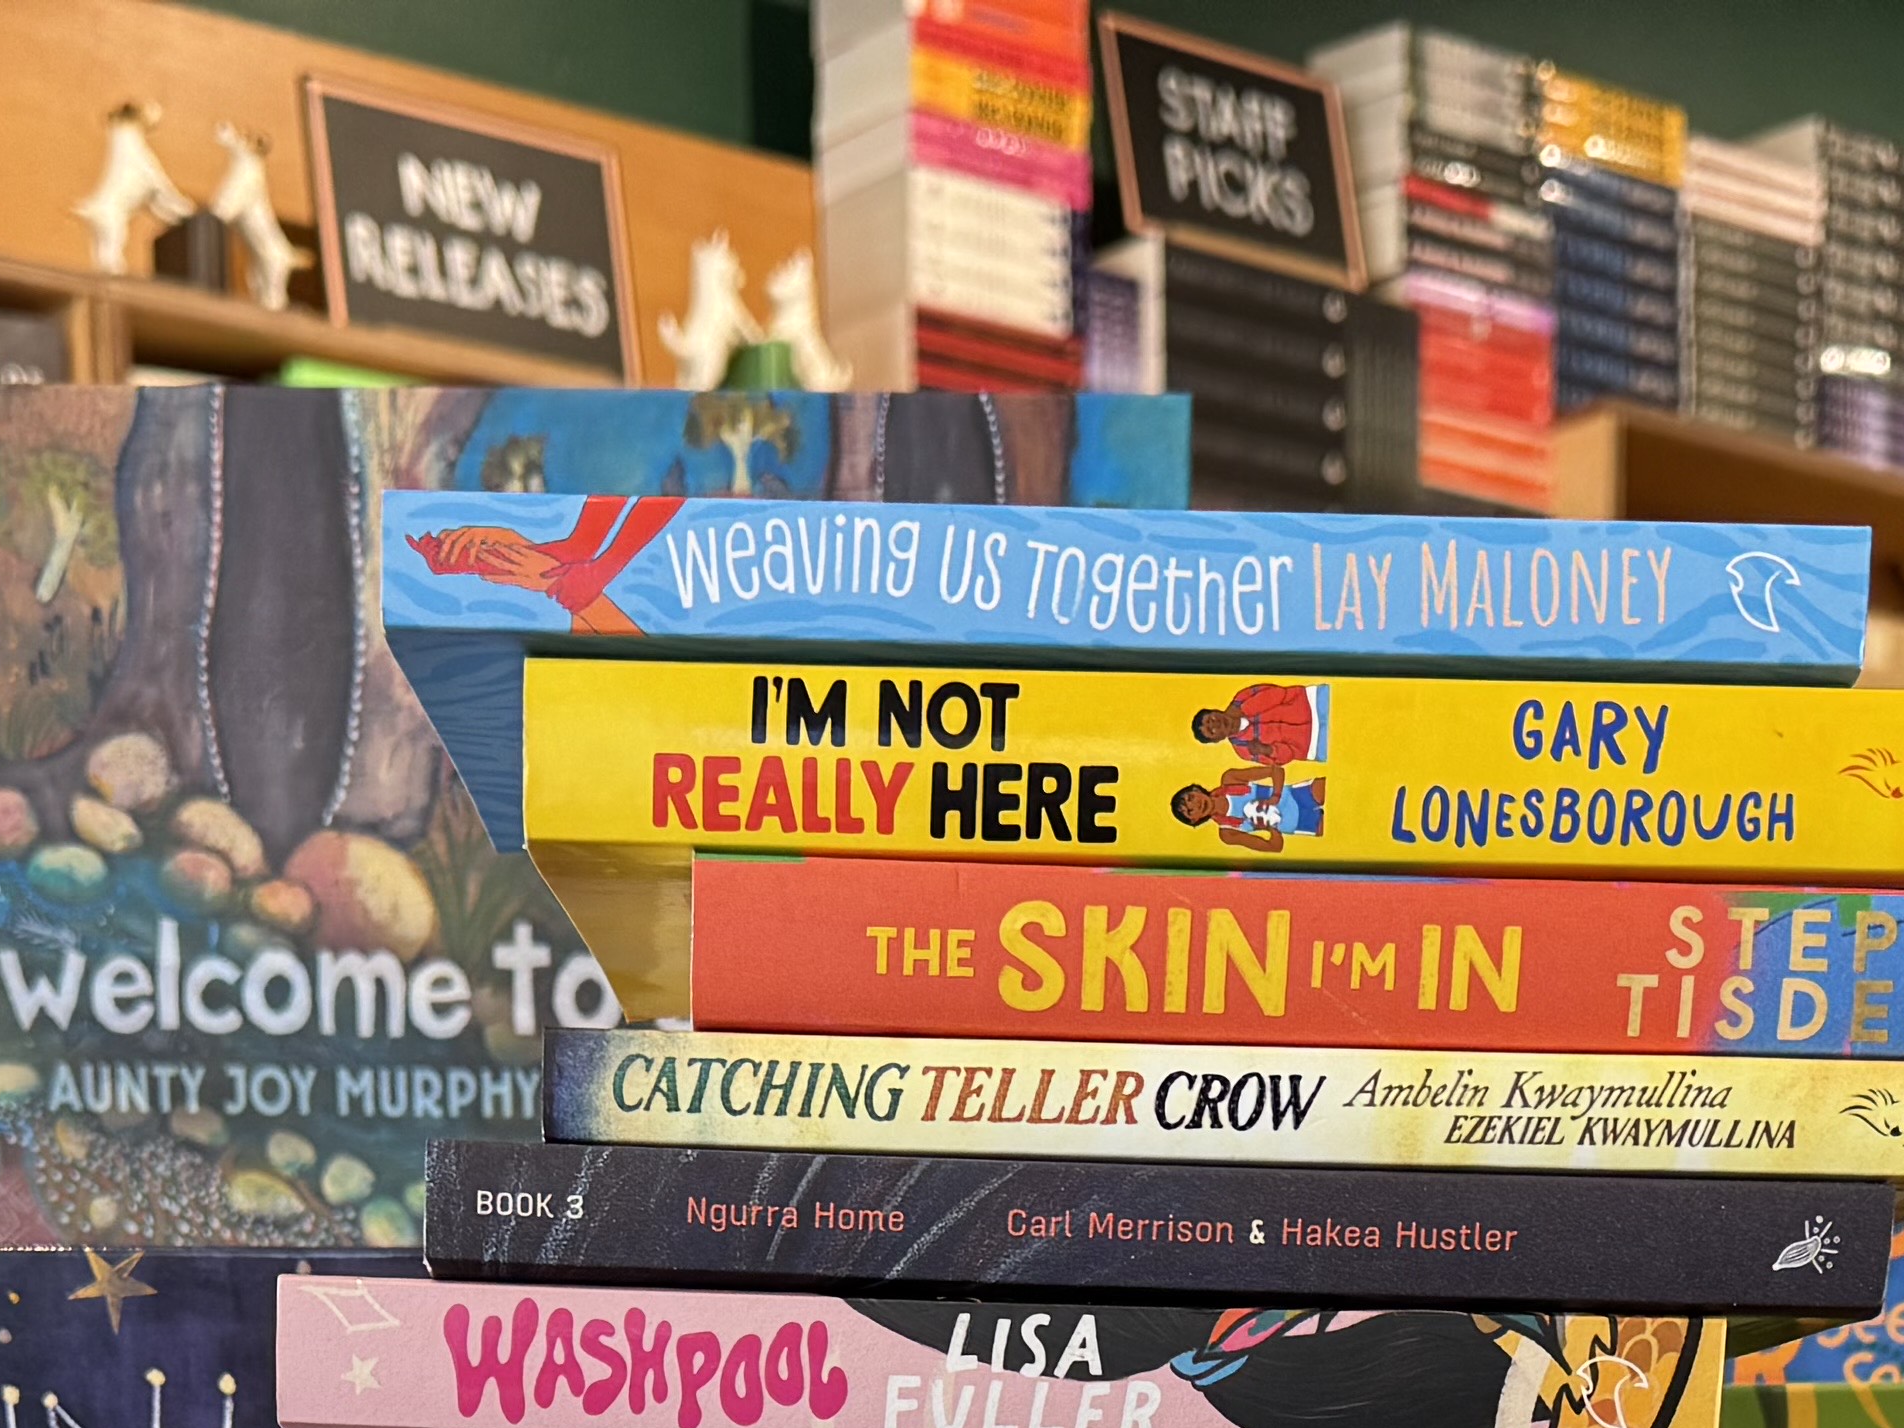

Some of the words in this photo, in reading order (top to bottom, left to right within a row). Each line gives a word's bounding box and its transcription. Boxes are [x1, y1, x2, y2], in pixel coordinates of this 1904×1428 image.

[1155, 68, 1294, 164] STAFF
[396, 151, 541, 244] NEW
[1161, 135, 1312, 234] PICKS
[343, 209, 608, 340] RELEASES
[1311, 542, 1394, 632] LAY
[1418, 537, 1674, 628] MALONEY
[751, 676, 852, 746] I'M
[880, 680, 1018, 751] NOT
[1512, 699, 1668, 776] GARY
[651, 752, 915, 838] REALLY
[930, 762, 1117, 844] HERE
[1391, 788, 1795, 849] LONESBOROUGH
[492, 919, 626, 1038] to
[50, 1062, 205, 1114] AUNTY
[225, 1064, 320, 1115] JOY
[337, 1068, 542, 1120] MURPHY
[611, 1055, 905, 1122] CATCHING
[920, 1066, 1144, 1129] TELLER
[1154, 1072, 1325, 1132] CROW
[1344, 1070, 1491, 1112] Ambelin
[1501, 1072, 1731, 1122] Kwaymullina
[1445, 1112, 1567, 1145] EZEKIEL
[1577, 1115, 1797, 1150] KWAYMULLINA
[476, 1190, 554, 1220] BOOK
[566, 1194, 585, 1222] 3
[687, 1196, 798, 1238] Ngurra
[815, 1200, 905, 1235] Home
[1006, 1206, 1072, 1240] Carl
[1086, 1210, 1235, 1246] Merrison
[1248, 1218, 1268, 1246] &
[1281, 1218, 1381, 1252] Hakea
[1394, 1220, 1518, 1255] Hustler
[947, 1312, 1101, 1380] LISA
